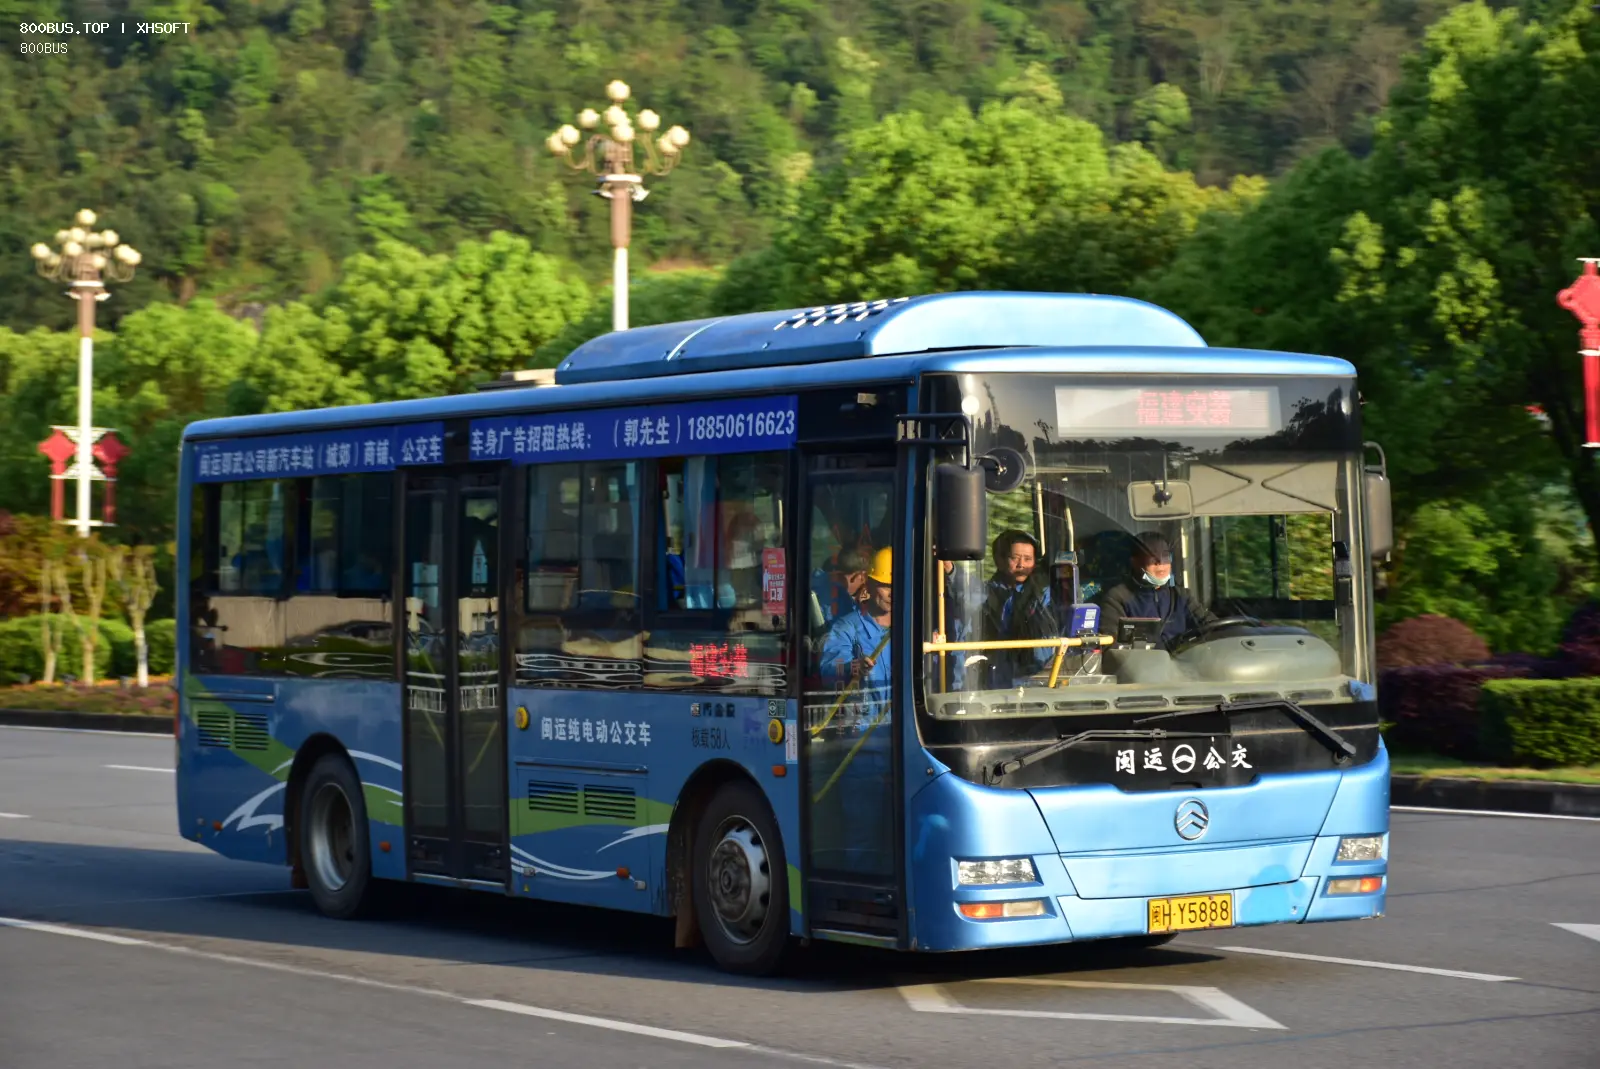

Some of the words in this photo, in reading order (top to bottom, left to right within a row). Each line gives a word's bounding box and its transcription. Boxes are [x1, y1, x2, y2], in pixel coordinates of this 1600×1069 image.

[541, 716, 652, 747] 闽运纯电动公交车
[1115, 747, 1167, 774] 闽运
[1203, 743, 1253, 770] 公交
